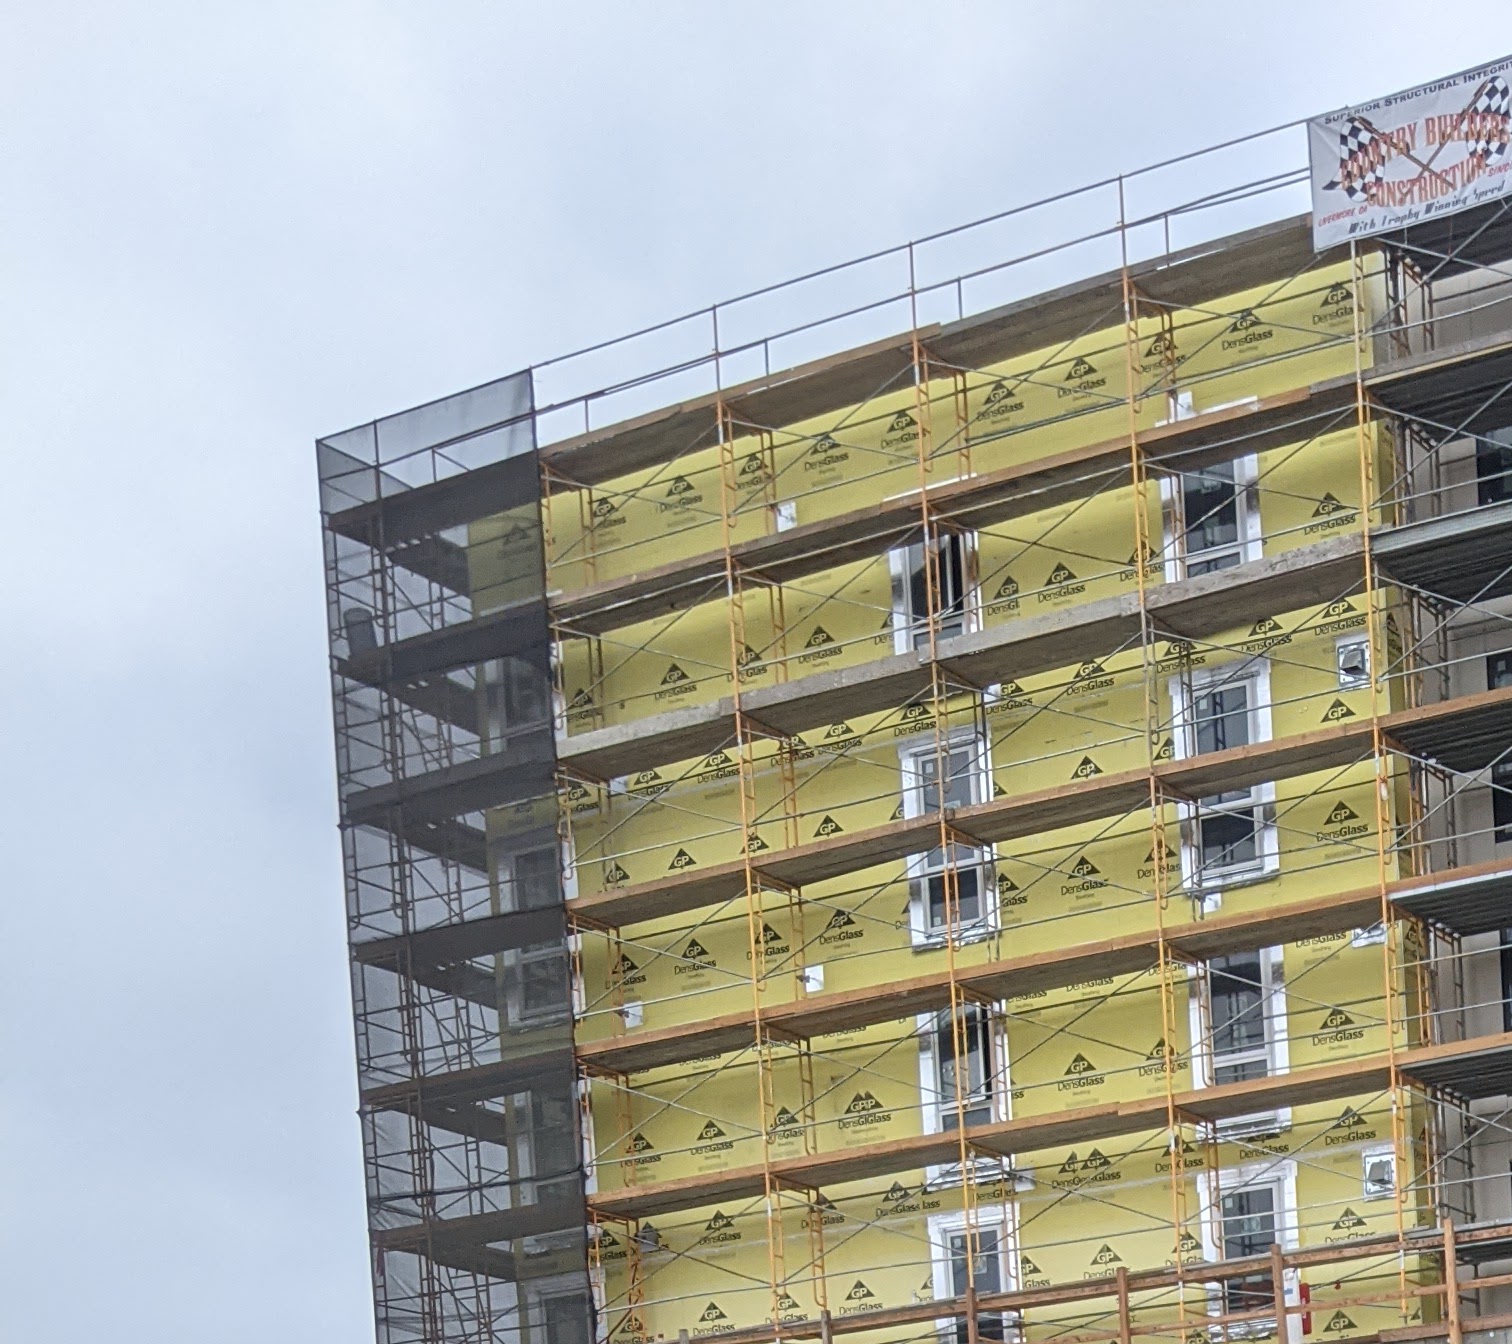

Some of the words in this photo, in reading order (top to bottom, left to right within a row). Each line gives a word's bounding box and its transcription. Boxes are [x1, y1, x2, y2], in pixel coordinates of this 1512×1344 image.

[1324, 100, 1381, 125] SUPERIOR
[1384, 78, 1460, 107] STRUCTURAL
[1424, 112, 1512, 147] BUILDERS
[1348, 217, 1376, 234] With
[1382, 207, 1420, 227] Trophy
[1424, 194, 1468, 214] Winning
[1328, 289, 1346, 304] GP
[1313, 307, 1354, 325] DensGla
[1222, 330, 1273, 350] DensGlass
[1071, 364, 1088, 377] GP
[893, 416, 910, 428] GP
[881, 431, 926, 450] DensGlas
[804, 452, 849, 471] DensGlass
[1051, 570, 1069, 583] GP
[1001, 583, 1017, 595] GP
[1038, 584, 1085, 602] DensGlass
[1329, 602, 1348, 614] GP
[1256, 621, 1274, 632] GP
[1315, 617, 1366, 635] DensGlass
[811, 632, 828, 644] GP
[666, 671, 681, 682] GP
[1001, 683, 1016, 696] GP
[1067, 678, 1114, 695] DensGlass
[905, 705, 923, 718] GP
[1328, 706, 1347, 719] GP
[829, 722, 847, 735] GP
[709, 753, 724, 766] GP
[698, 766, 741, 783] DensGlas
[1077, 763, 1095, 776] GP
[639, 771, 655, 784] GP
[1330, 808, 1350, 821] GP
[820, 822, 836, 834] GP
[1317, 824, 1368, 841] DensGlass
[674, 854, 690, 866] GP
[1074, 864, 1092, 875] GP
[820, 929, 863, 944] DensGlass
[686, 946, 701, 958] GP
[674, 961, 716, 975] DensGlass
[1326, 1014, 1346, 1027] GP
[1313, 1030, 1364, 1046] DensGlass
[1070, 1061, 1088, 1073] GP
[1058, 1076, 1105, 1091] DensGlass
[702, 1127, 718, 1138] GP
[1325, 1130, 1376, 1146] DensGlass
[1096, 1251, 1114, 1262] GP
[851, 1288, 868, 1299] GP
[778, 1298, 792, 1309] GP
[839, 1302, 883, 1314] DensGlass
[704, 1309, 719, 1320] GP
[1330, 1318, 1348, 1328] GP
